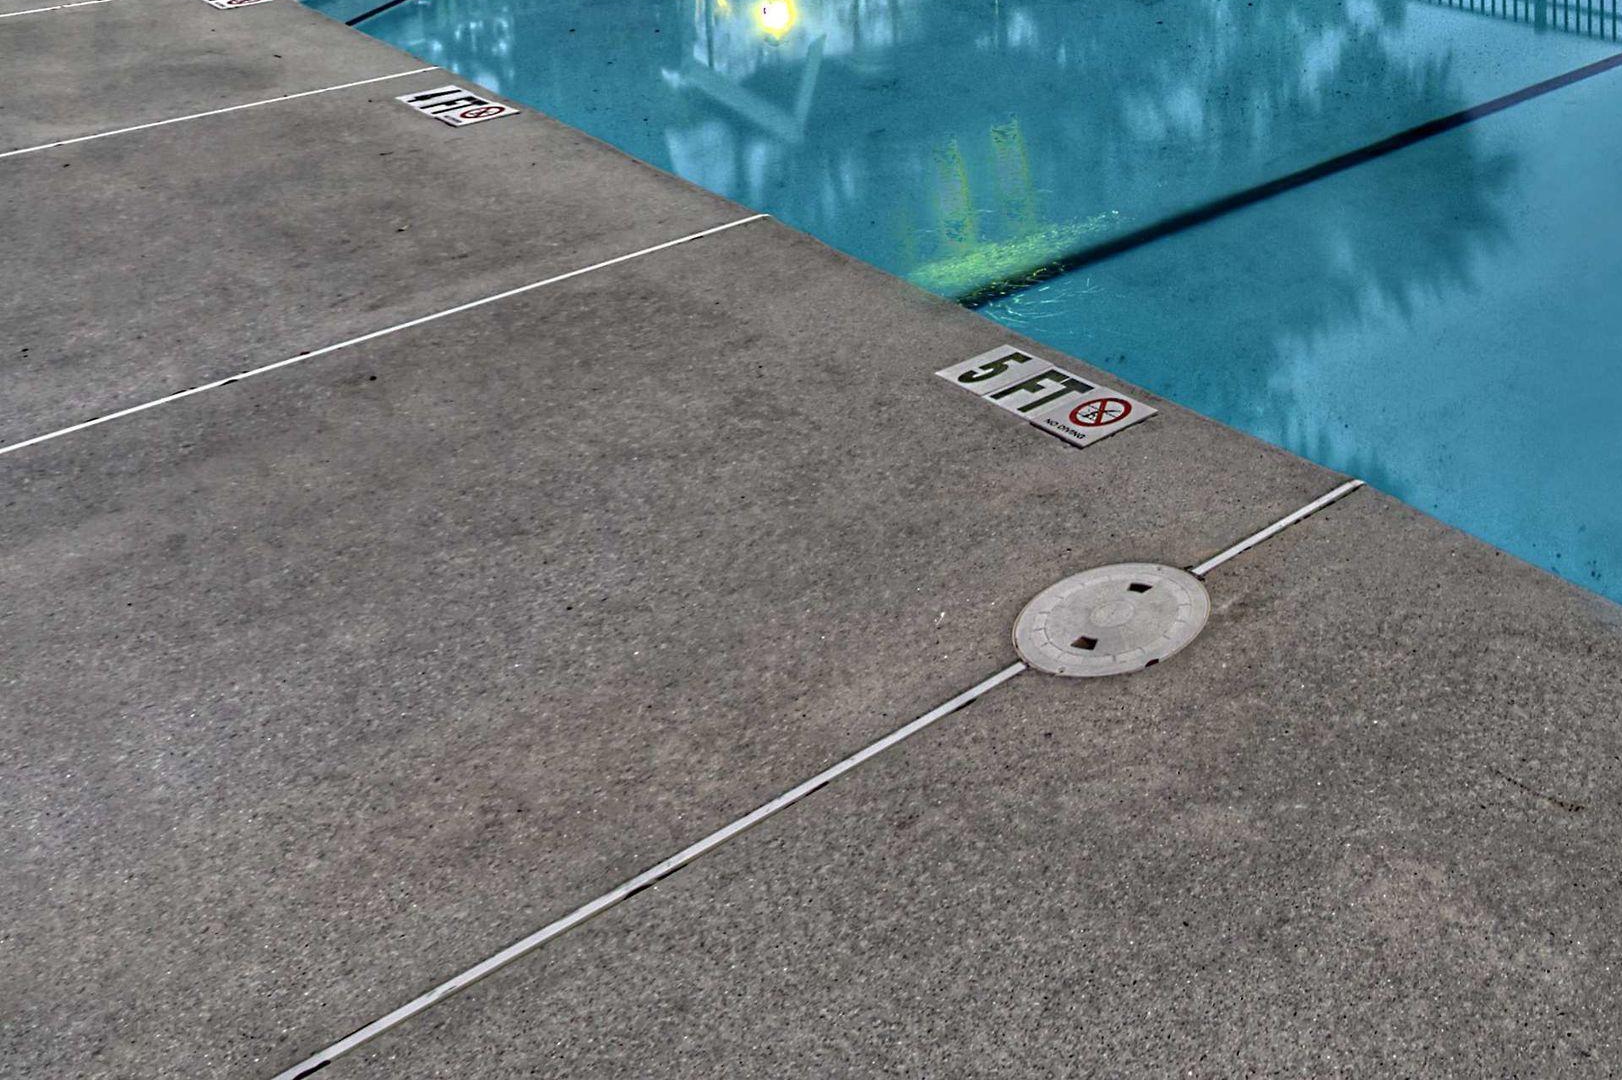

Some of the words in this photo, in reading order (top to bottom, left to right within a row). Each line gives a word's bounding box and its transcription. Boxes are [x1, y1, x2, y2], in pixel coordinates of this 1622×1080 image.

[420, 96, 489, 114] FT
[957, 352, 1032, 384] 5
[989, 368, 1095, 413] FT
